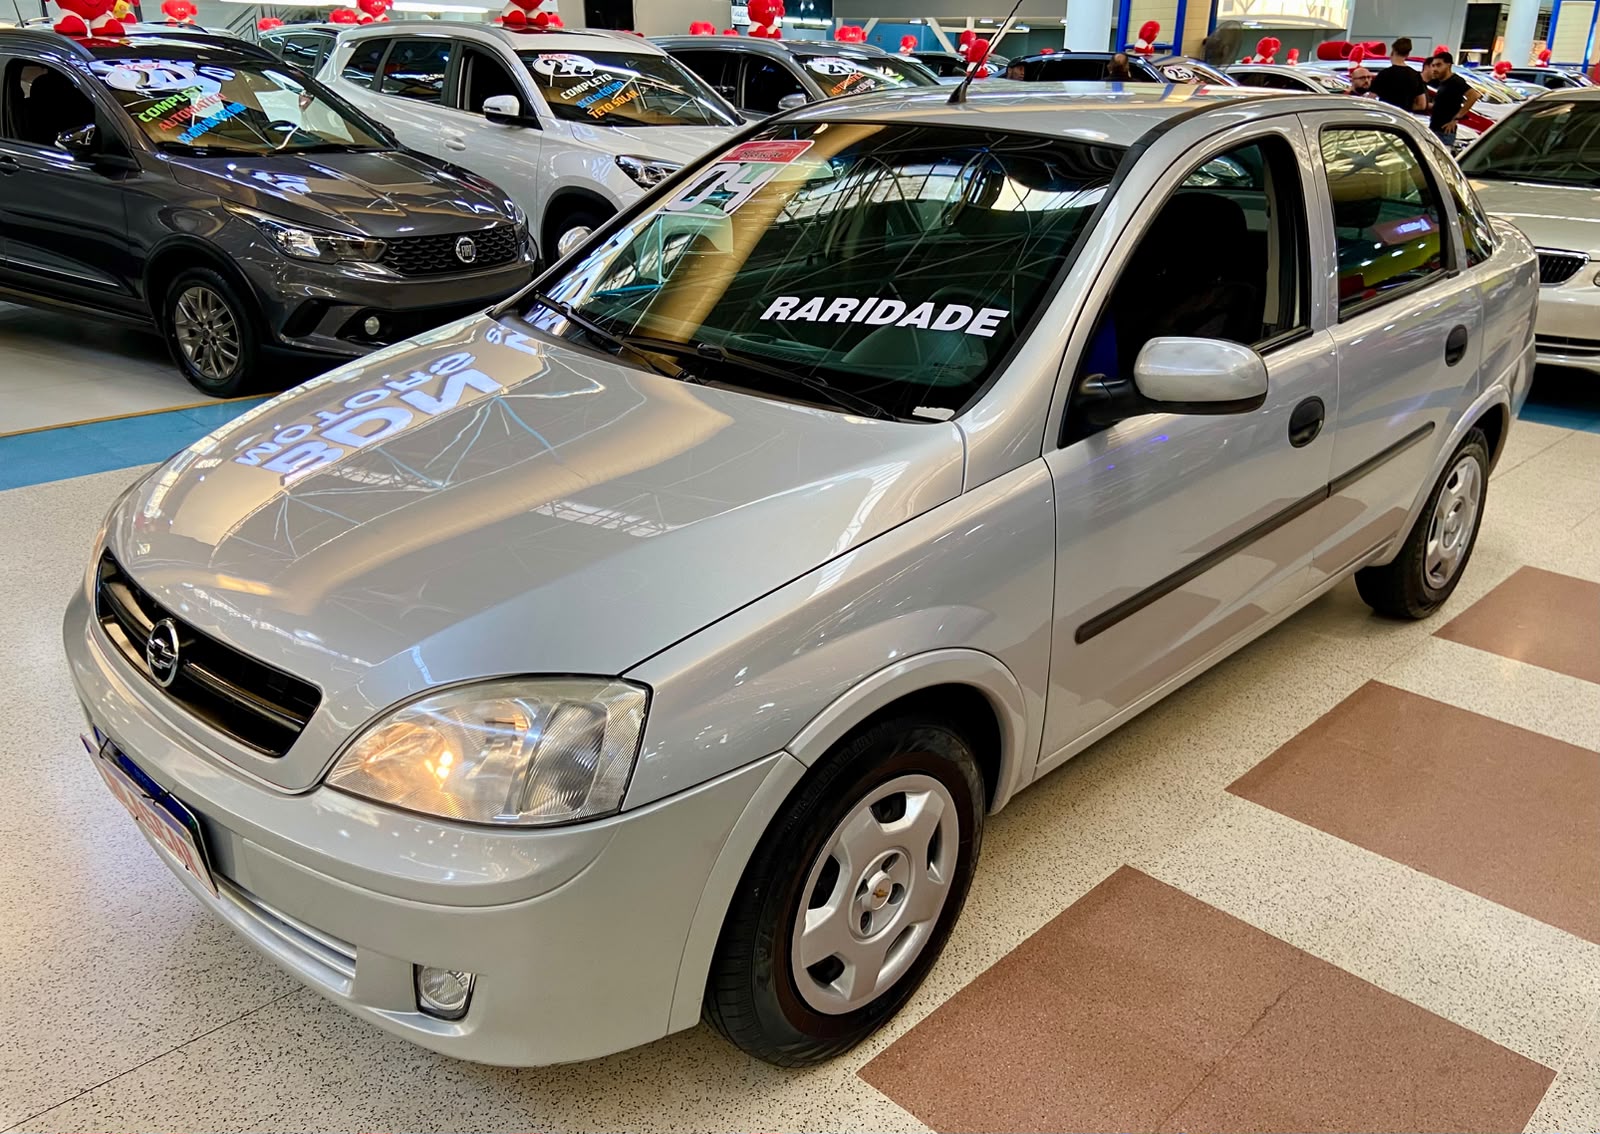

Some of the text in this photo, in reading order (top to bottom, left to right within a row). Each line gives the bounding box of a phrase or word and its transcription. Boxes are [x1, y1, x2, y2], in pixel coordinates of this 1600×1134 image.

[560, 73, 614, 100] COMPLETO
[1168, 68, 1191, 79] 25
[589, 90, 639, 119] TETO SOLAR
[665, 163, 776, 212] 04
[760, 295, 1010, 337] RARIDADE
